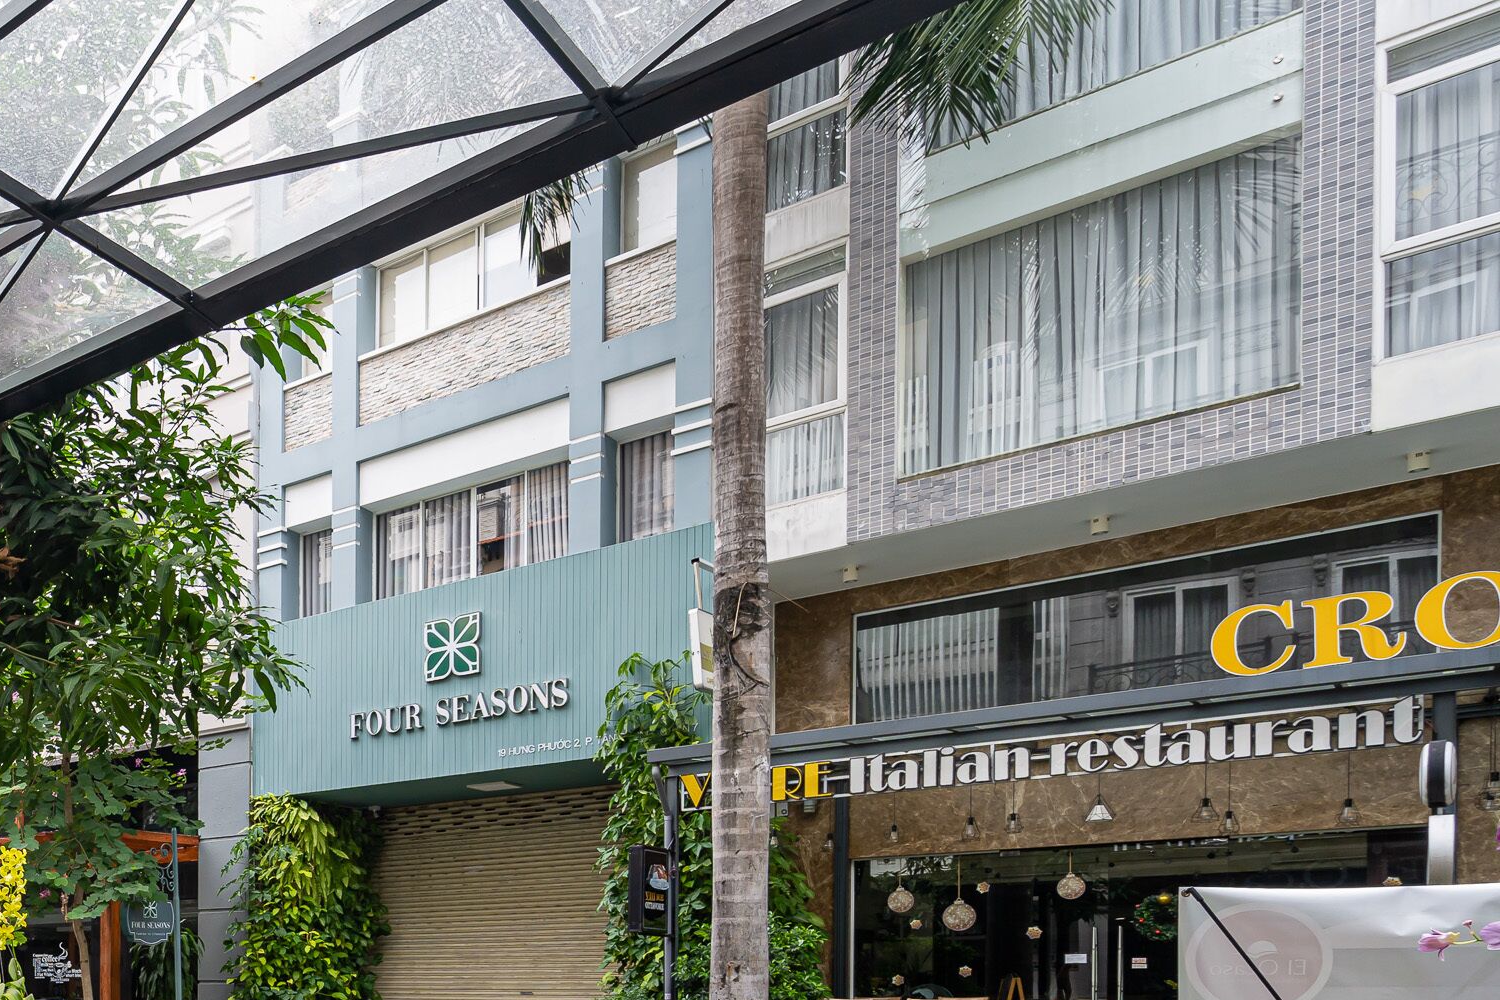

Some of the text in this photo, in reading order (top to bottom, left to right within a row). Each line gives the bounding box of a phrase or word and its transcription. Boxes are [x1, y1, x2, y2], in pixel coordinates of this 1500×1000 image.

[1211, 571, 1500, 676] CRO
[349, 678, 569, 740] FOUR SEASONS
[498, 748, 506, 757] 19
[679, 694, 1424, 808] VRE Italian restaurant
[131, 921, 171, 929] FOUR SEASONS
